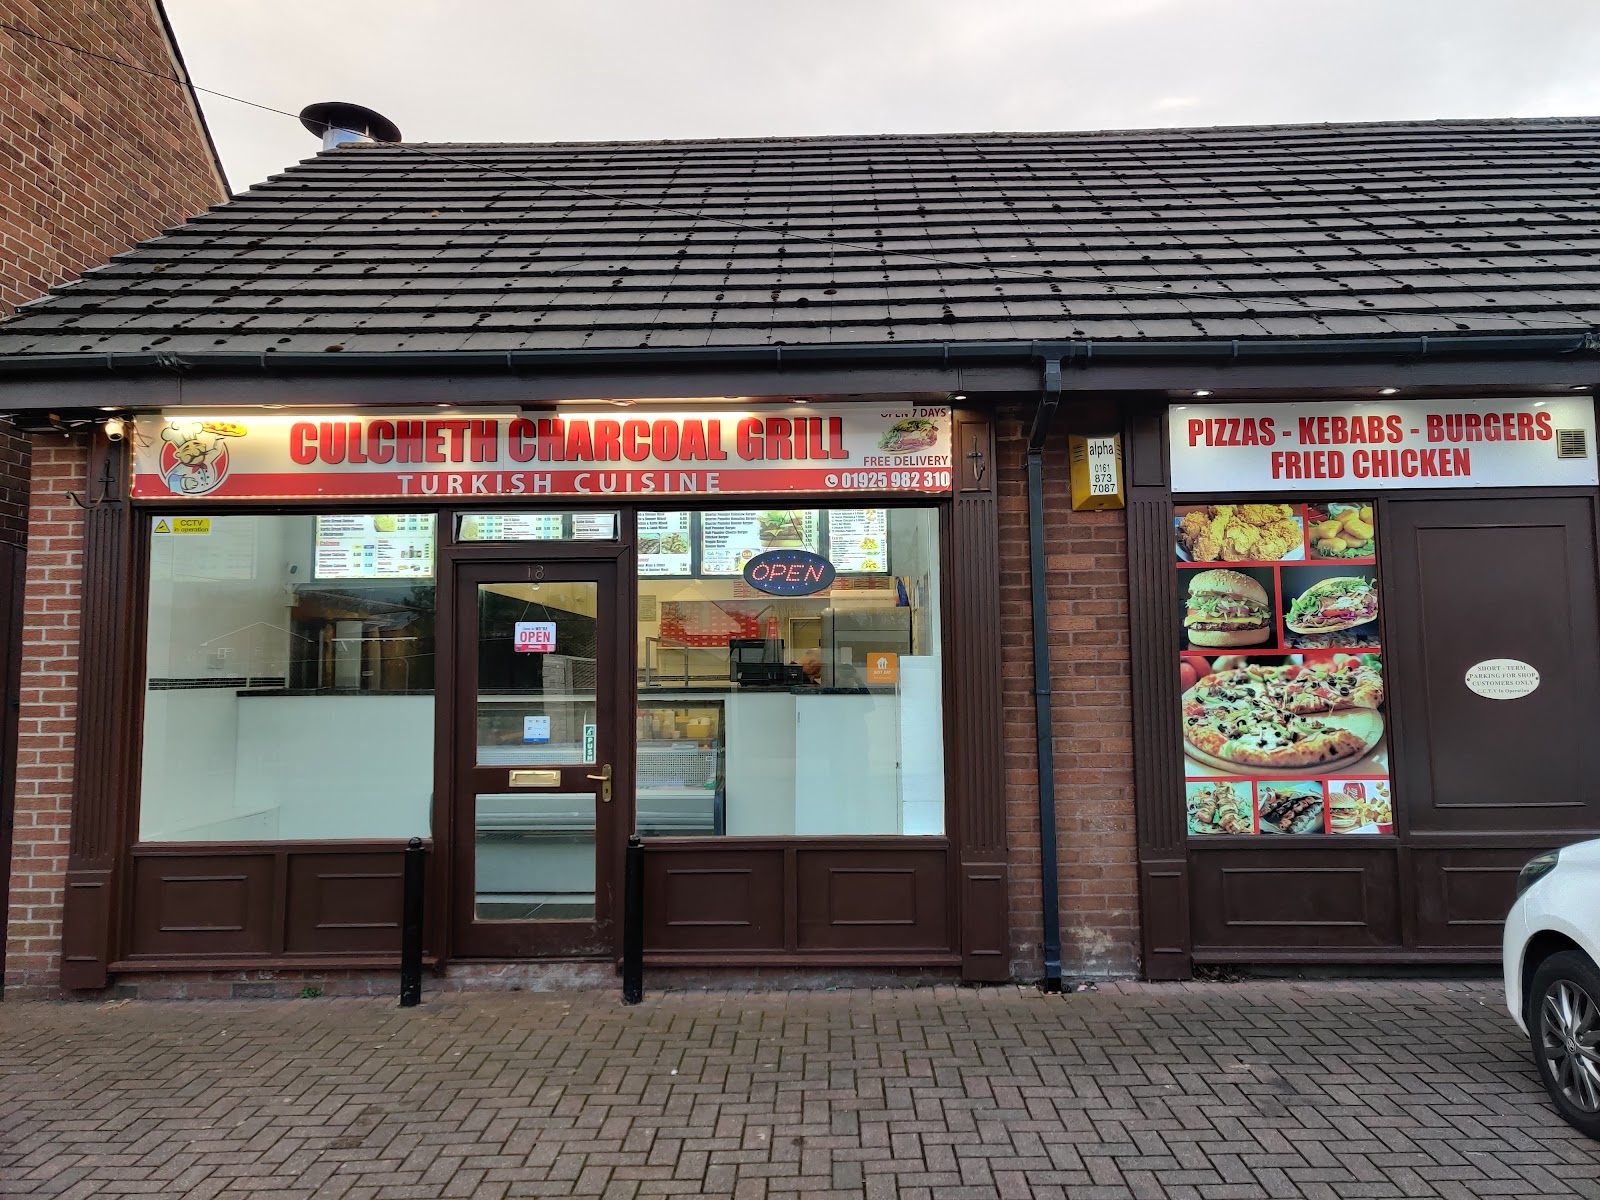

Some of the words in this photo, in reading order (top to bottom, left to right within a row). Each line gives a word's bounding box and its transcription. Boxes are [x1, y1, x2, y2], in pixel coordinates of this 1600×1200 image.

[912, 409, 917, 417] 7
[920, 408, 946, 418] DAYS
[1188, 418, 1276, 446] PIZZAS
[1298, 415, 1403, 444] KEBABS
[1426, 412, 1553, 442] BURGERS
[290, 420, 498, 464] CULCHETH
[508, 418, 728, 462] CHARCOAL
[737, 416, 848, 461] GRILL
[1090, 441, 1114, 458] alpha
[864, 456, 890, 466] FREE
[894, 456, 948, 466] DELIVERY
[1094, 464, 1110, 472] 0161
[1272, 451, 1344, 479] FRIED
[1352, 448, 1470, 478] CHICKEN
[398, 474, 552, 494] TURKISH
[574, 472, 720, 492] CUISINE
[842, 472, 888, 488] 01925
[890, 472, 920, 488] 982
[924, 471, 950, 487] 310
[1094, 474, 1112, 482] 873
[1092, 484, 1115, 492] 7087
[528, 565, 544, 580] 18
[752, 564, 824, 582] OPEN
[520, 632, 550, 642] OPEN
